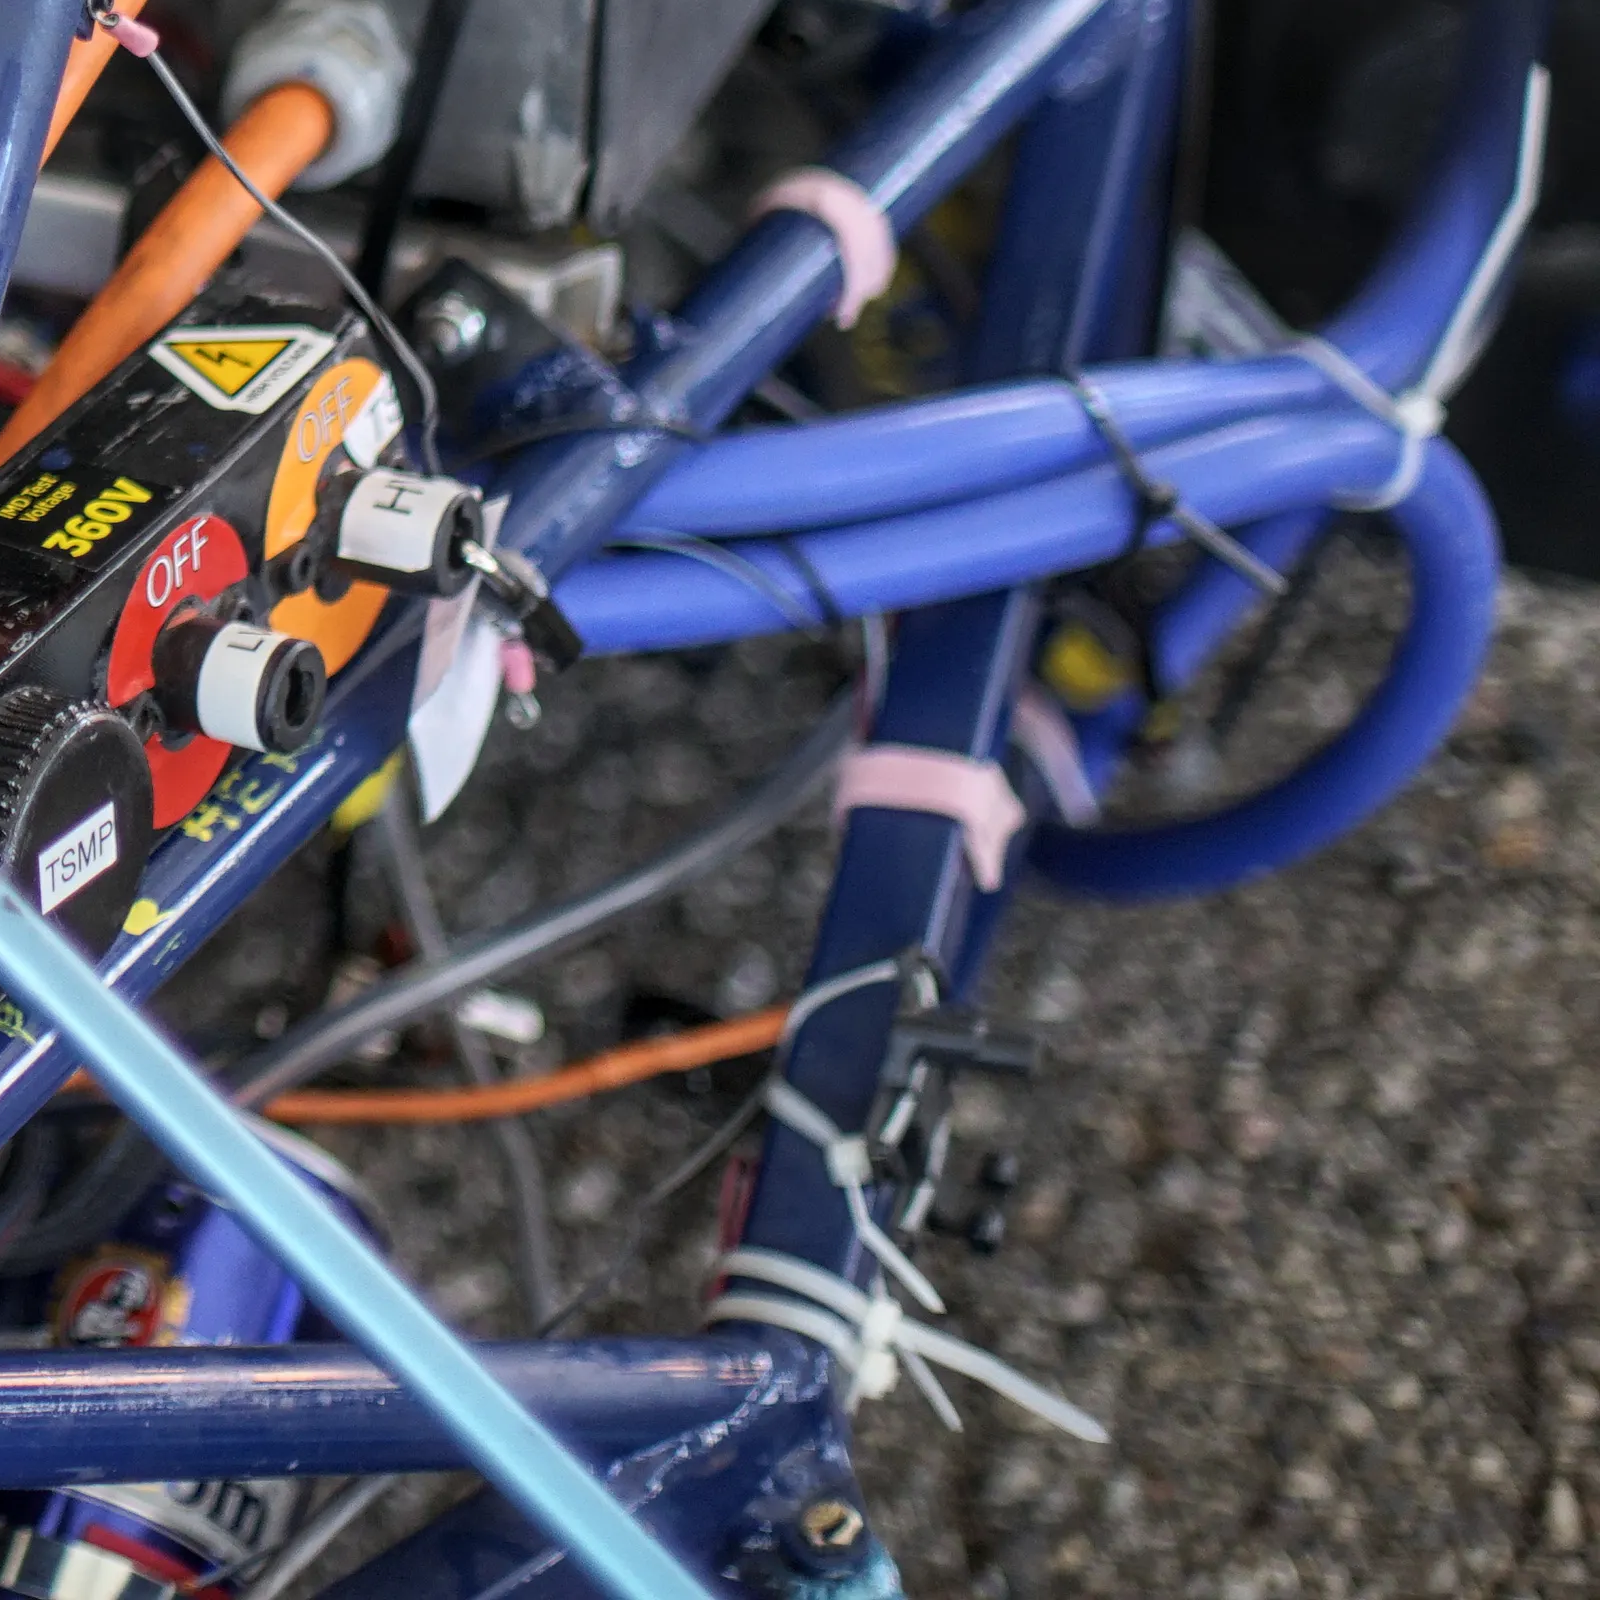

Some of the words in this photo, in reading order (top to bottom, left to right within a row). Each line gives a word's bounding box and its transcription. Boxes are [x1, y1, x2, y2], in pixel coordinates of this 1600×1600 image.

[297, 377, 353, 463] OFF
[21, 482, 76, 522] Voltage
[22, 472, 56, 505] Test
[44, 477, 153, 558] 360V
[147, 519, 210, 609] OFF
[44, 819, 114, 894] TSMP
